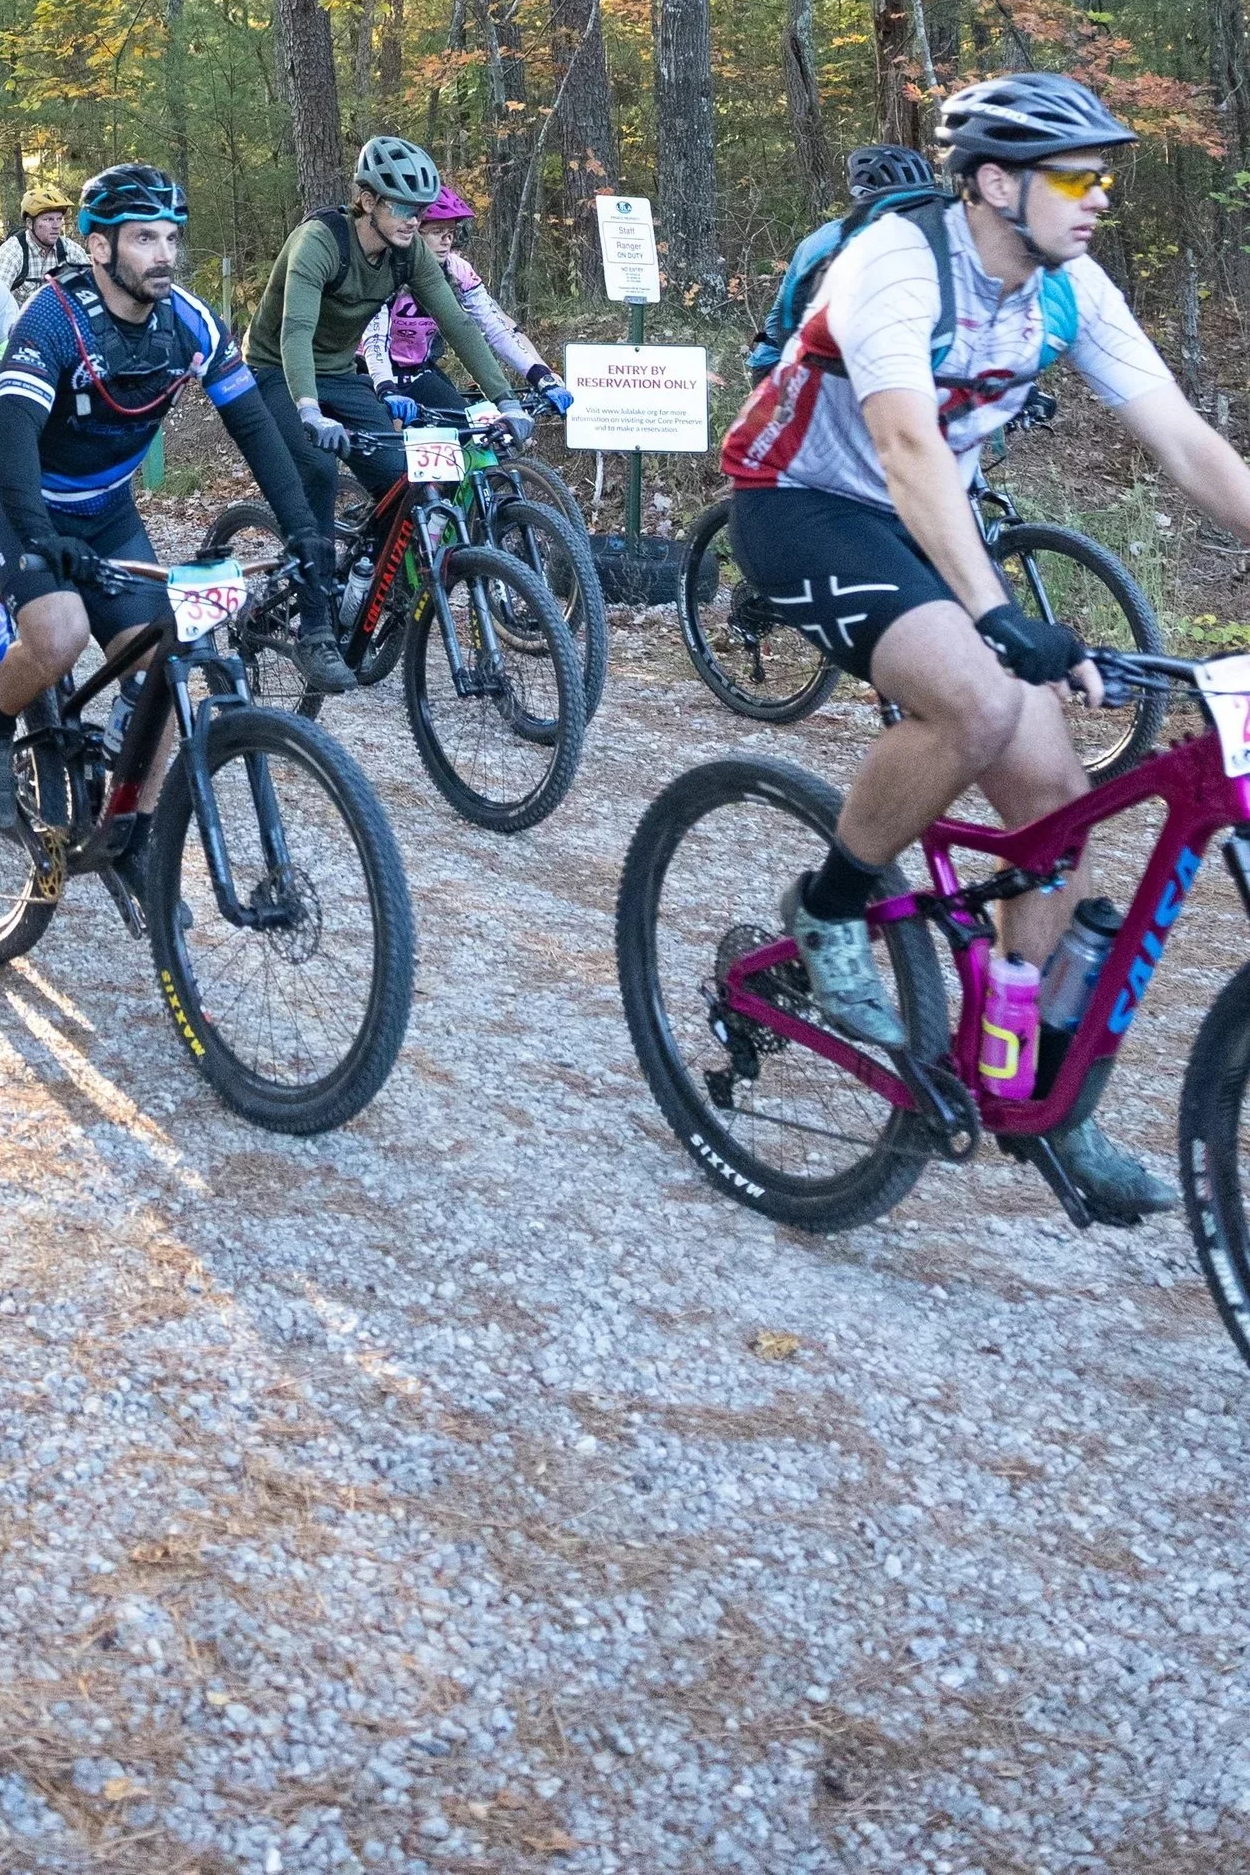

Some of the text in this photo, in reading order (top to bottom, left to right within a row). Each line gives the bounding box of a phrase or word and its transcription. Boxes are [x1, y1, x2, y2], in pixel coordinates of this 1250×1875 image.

[618, 226, 635, 235] Staff
[616, 241, 642, 252] Ranger
[617, 251, 627, 259] ON
[608, 364, 666, 376] ENTRY BY
[577, 377, 697, 390] RESERVATION ONLY
[621, 416, 644, 425] visiting
[657, 417, 674, 425] Core
[417, 444, 456, 467] 373
[184, 586, 239, 620] 336
[1106, 845, 1202, 1035] SALSA
[161, 969, 205, 1056] MAXXIS
[690, 1133, 766, 1198] MAXXIS
